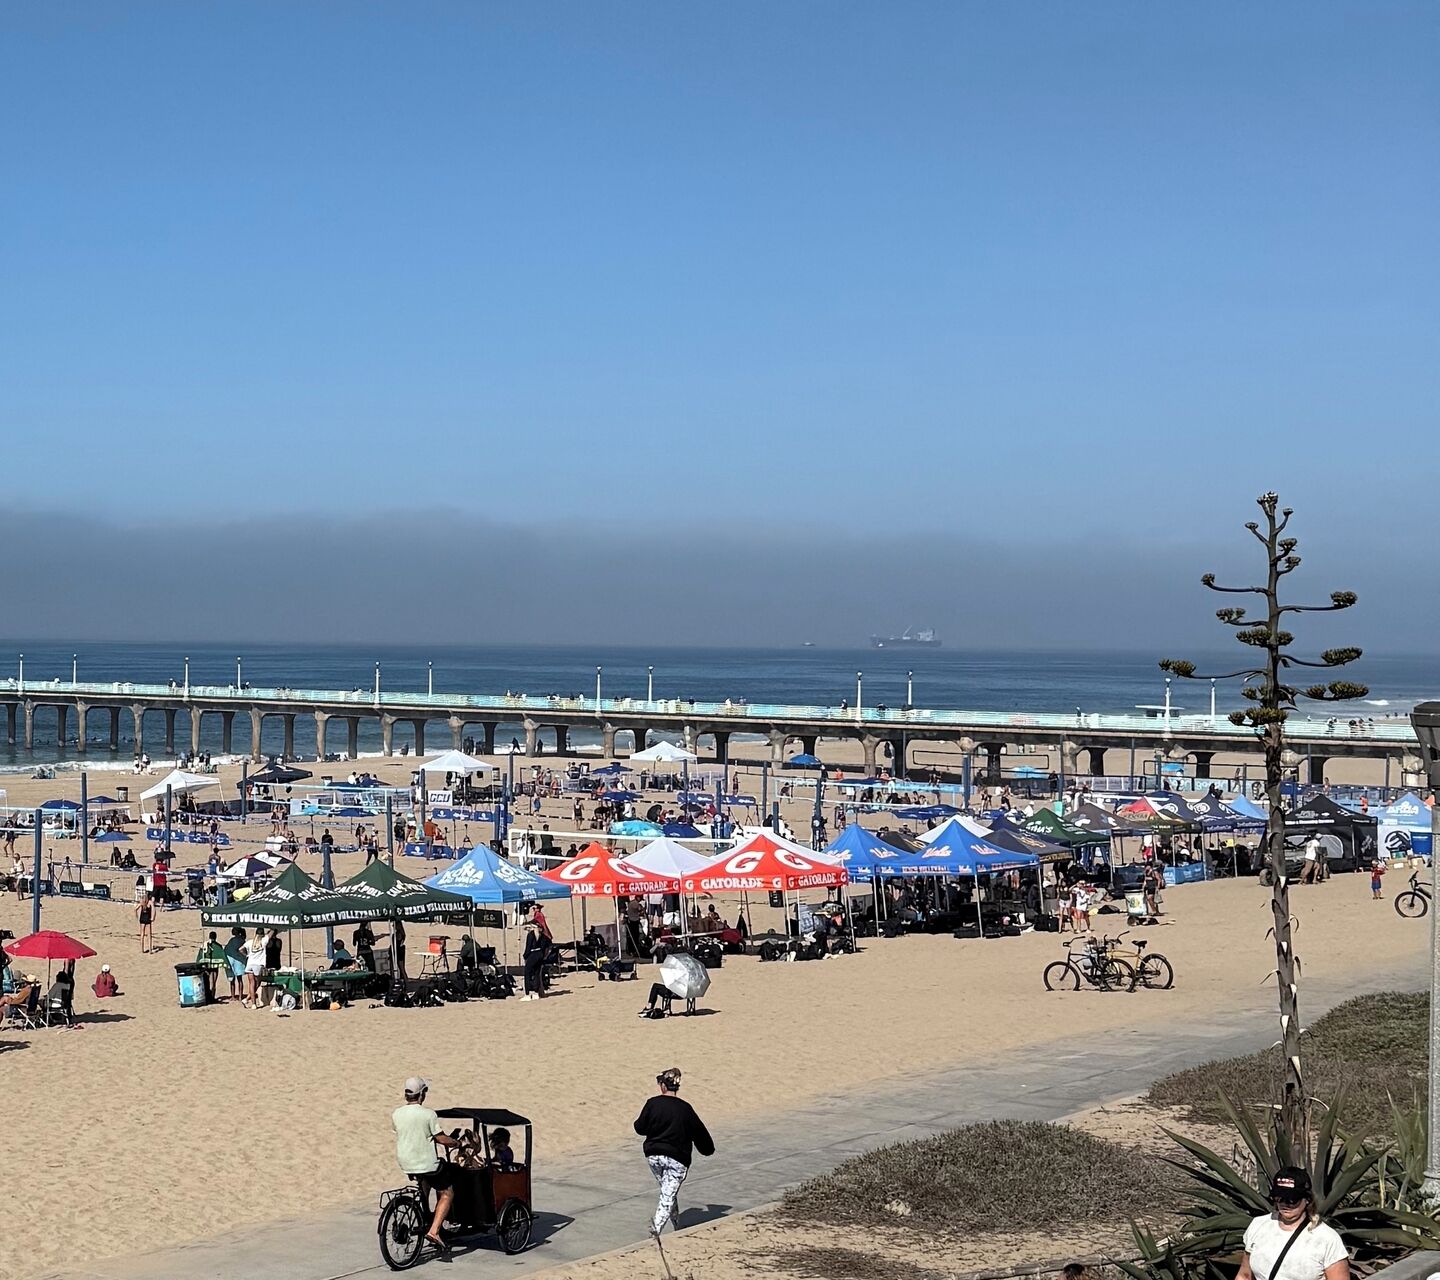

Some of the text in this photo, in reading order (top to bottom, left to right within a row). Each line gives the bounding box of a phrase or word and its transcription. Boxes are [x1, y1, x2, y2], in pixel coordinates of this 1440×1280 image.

[725, 851, 765, 874] G
[774, 849, 813, 870] G
[560, 857, 600, 880] G
[608, 858, 645, 878] G
[700, 877, 764, 889] GATORADE
[772, 877, 782, 889] G
[788, 876, 795, 888] G
[798, 872, 837, 887] GATORADE
[840, 871, 847, 883] G
[603, 883, 613, 894] G
[618, 883, 626, 893] G
[629, 881, 668, 893] GATORADE
[672, 880, 680, 890] G
[685, 879, 694, 890] G
[360, 885, 384, 897] POLY
[403, 901, 465, 915] BEACH VOLLEYBALL
[211, 913, 289, 925] BEACH VOLLEYBALL
[311, 908, 381, 923] BEACH VOLLEYBALL
